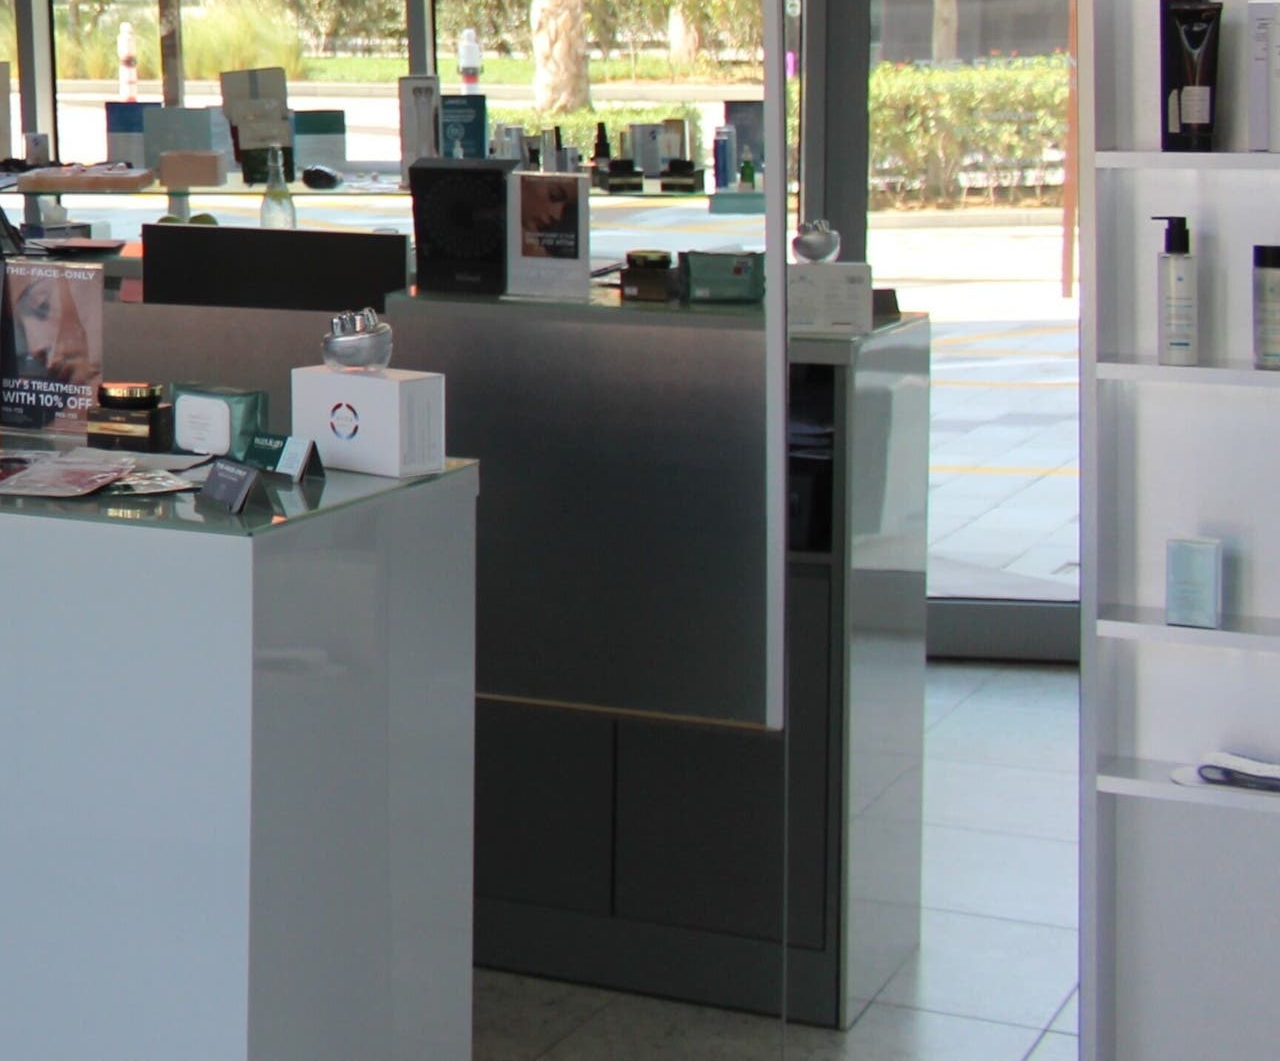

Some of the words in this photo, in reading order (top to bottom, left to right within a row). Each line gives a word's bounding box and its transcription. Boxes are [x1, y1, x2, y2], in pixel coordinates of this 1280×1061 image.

[2, 378, 21, 391] BUY
[31, 380, 93, 396] TREATMENTS
[2, 391, 37, 406] WITH
[39, 393, 64, 409] 10%
[66, 397, 93, 410] OFF
